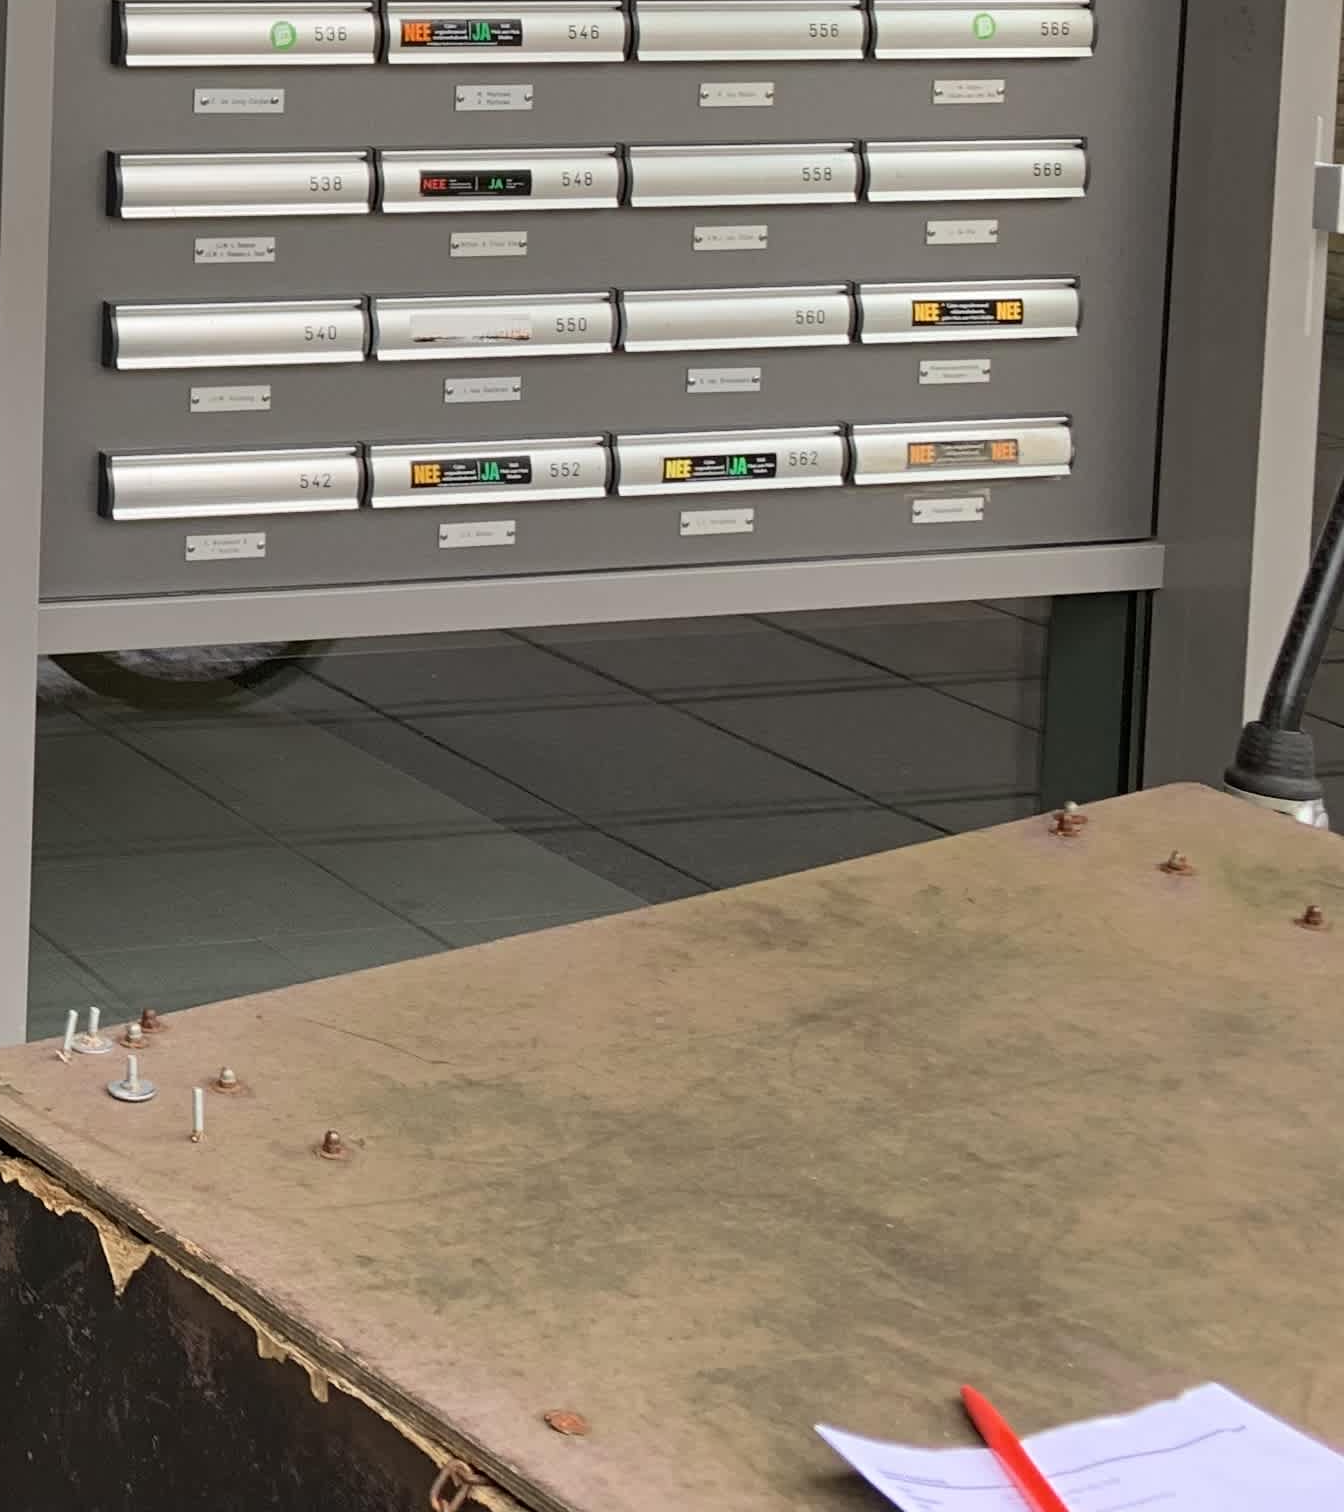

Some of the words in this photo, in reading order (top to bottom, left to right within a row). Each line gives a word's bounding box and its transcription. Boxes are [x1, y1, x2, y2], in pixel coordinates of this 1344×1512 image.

[314, 26, 348, 42] 536
[404, 22, 431, 41] NEE
[472, 22, 491, 41] JA
[568, 25, 600, 40] 546
[809, 23, 839, 39] 556
[1041, 21, 1070, 37] 566
[802, 167, 832, 182] 558
[1032, 162, 1062, 177] 568
[309, 176, 343, 192] 538
[423, 178, 447, 190] NEE
[489, 178, 503, 189] JA
[562, 172, 593, 187] 548
[795, 310, 825, 325] 560
[914, 304, 940, 322] NEE
[996, 302, 1021, 320] NEE
[556, 317, 587, 333] 550
[304, 325, 338, 342] 540
[729, 457, 748, 475] JA
[789, 451, 818, 466] 562
[414, 464, 440, 484] NEE
[481, 462, 500, 480] JA
[550, 463, 581, 478] 552
[666, 459, 692, 479] NEE
[300, 473, 332, 489] 542
